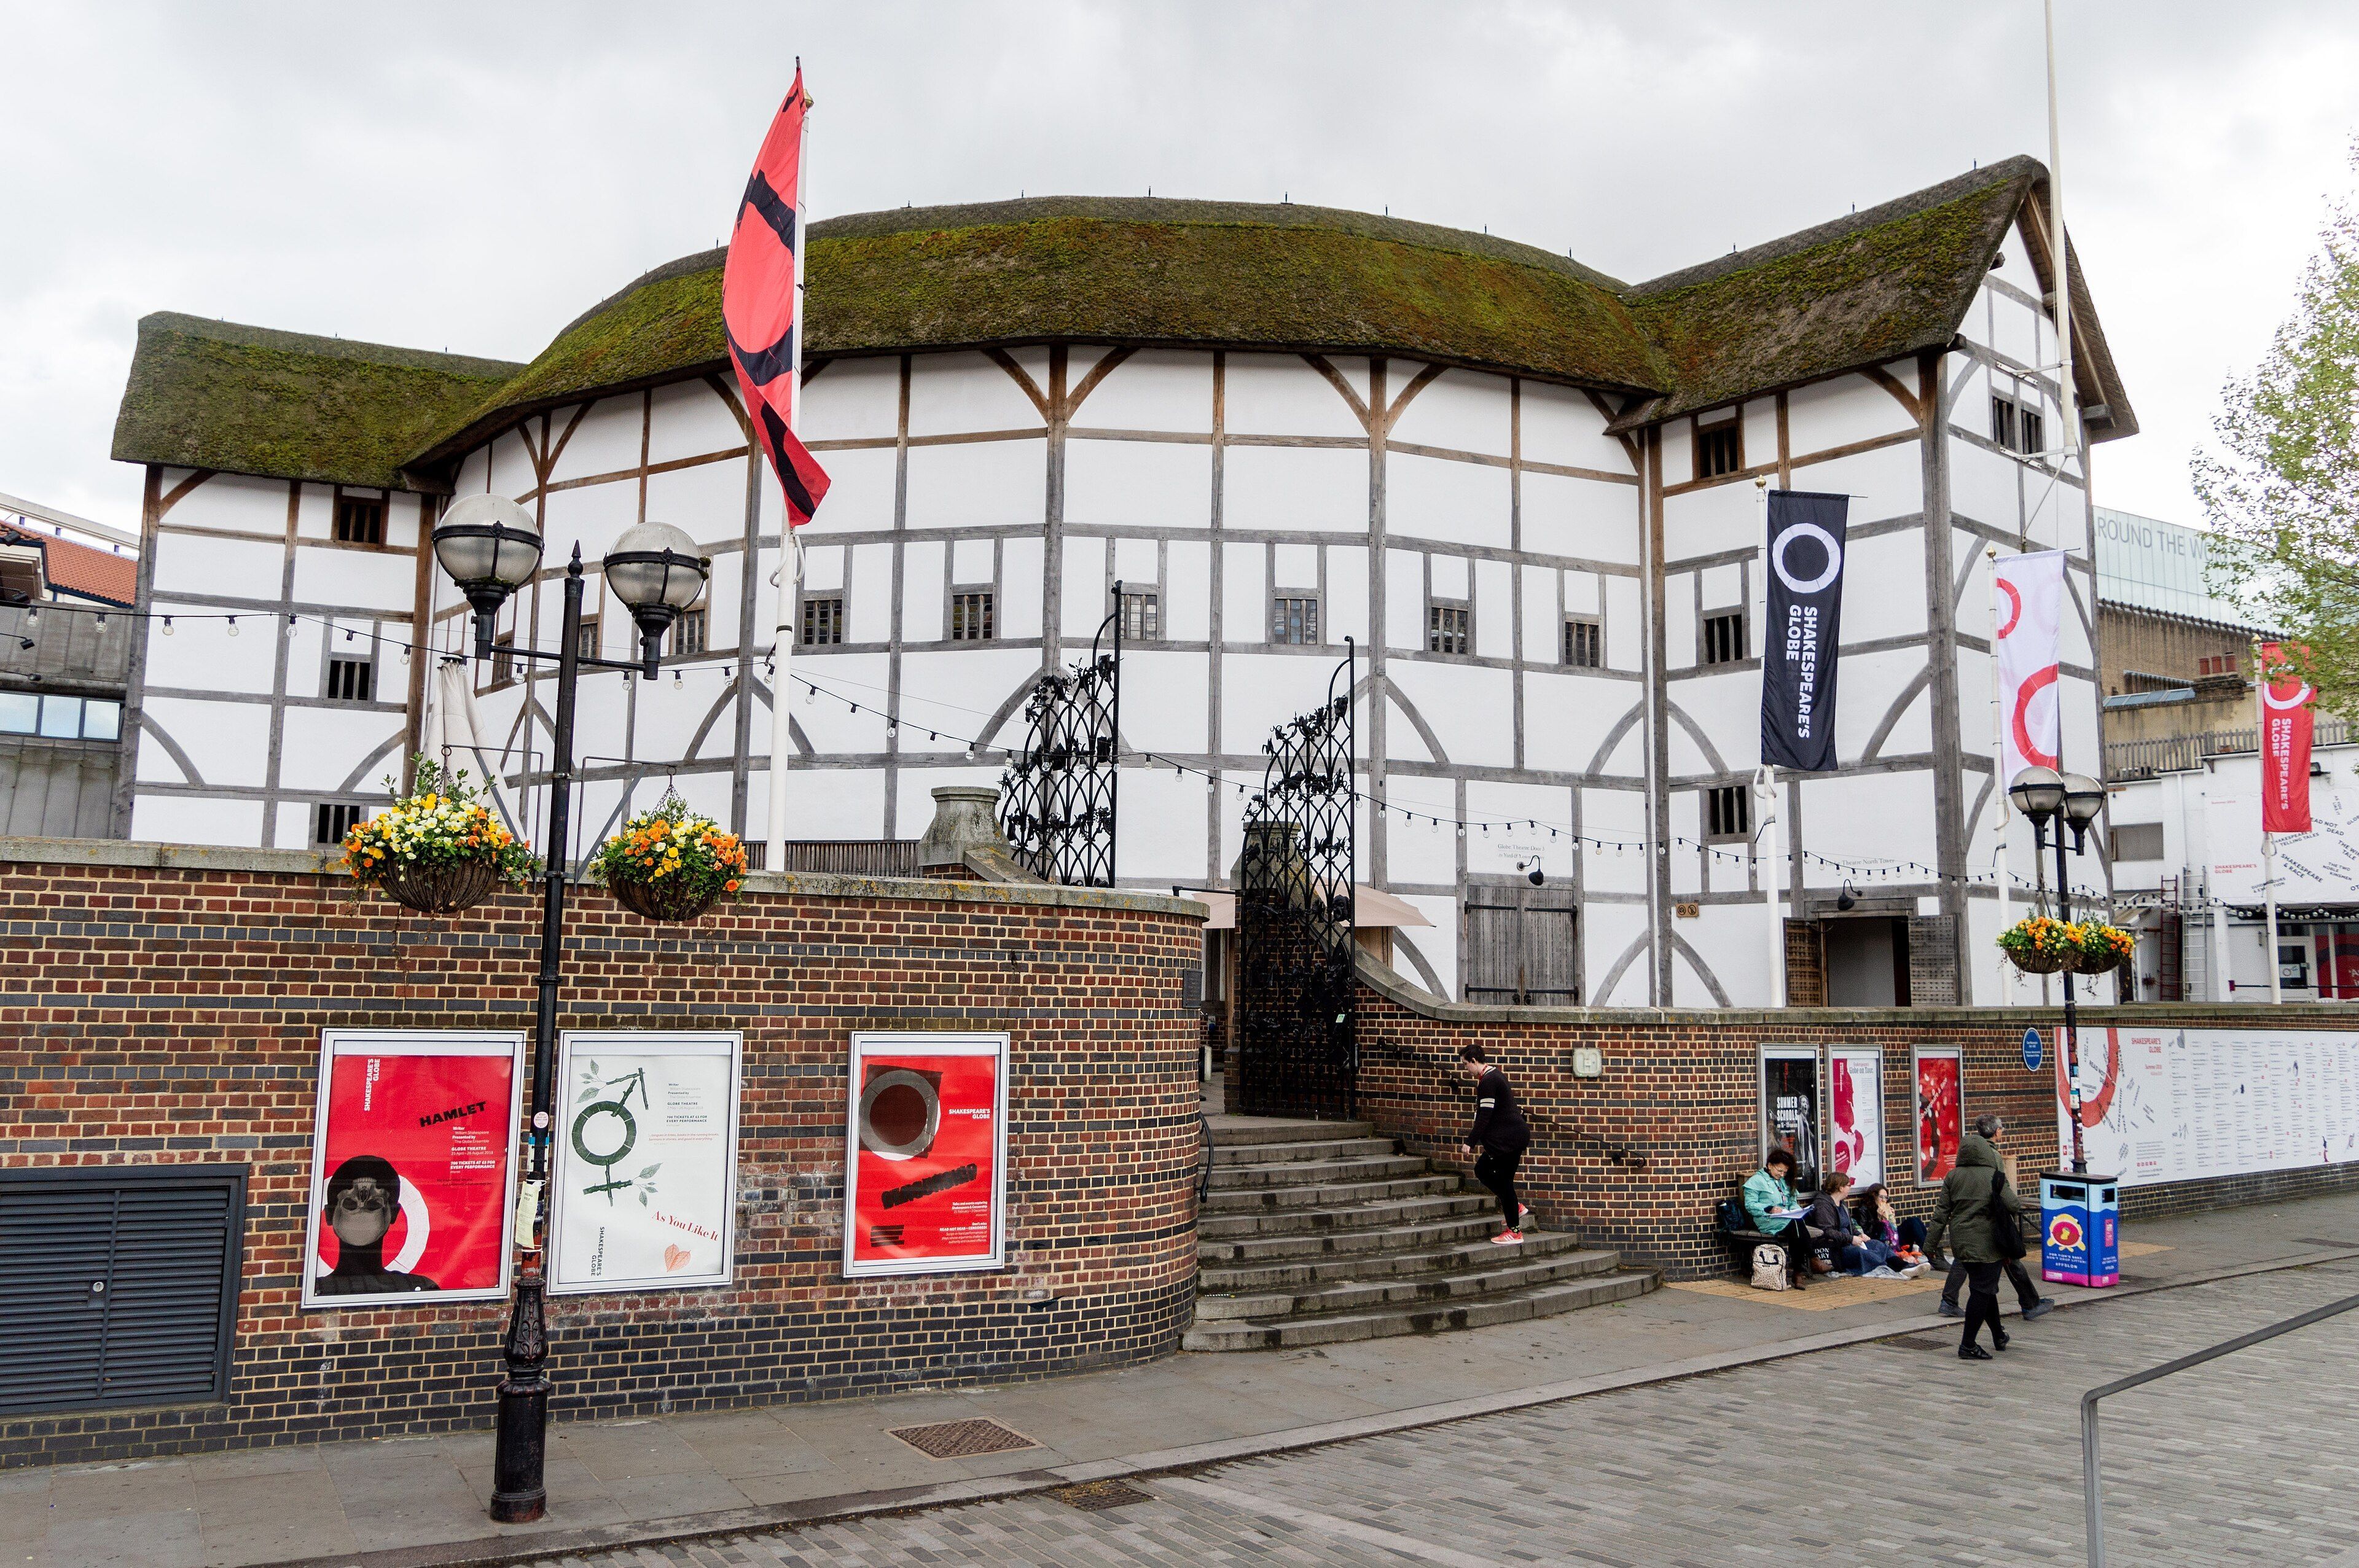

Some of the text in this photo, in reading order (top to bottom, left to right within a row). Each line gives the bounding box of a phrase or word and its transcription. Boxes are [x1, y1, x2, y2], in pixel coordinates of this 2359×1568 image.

[2094, 517, 2185, 556] ROUND THE
[1786, 604, 1801, 661] GLOBE
[1798, 606, 1817, 738] SHAKESPEARE'S
[2272, 718, 2280, 757] GLOBE
[2280, 718, 2291, 810] SHAKESPEARE'S
[2280, 837, 2302, 846] TELLING
[2338, 840, 2349, 849] THE
[2342, 849, 2357, 860] TALE
[2281, 854, 2324, 883] SHAKESPEARE
[2289, 866, 2306, 878] RACE
[2330, 872, 2352, 881] KINSMEN
[364, 1058, 374, 1111] SHAKESPEARE'S
[420, 1101, 486, 1127] HAMLET
[1777, 1096, 1798, 1109] SUMMER
[1777, 1109, 1798, 1121] SCHOOLS
[651, 1211, 719, 1241] As You Like It
